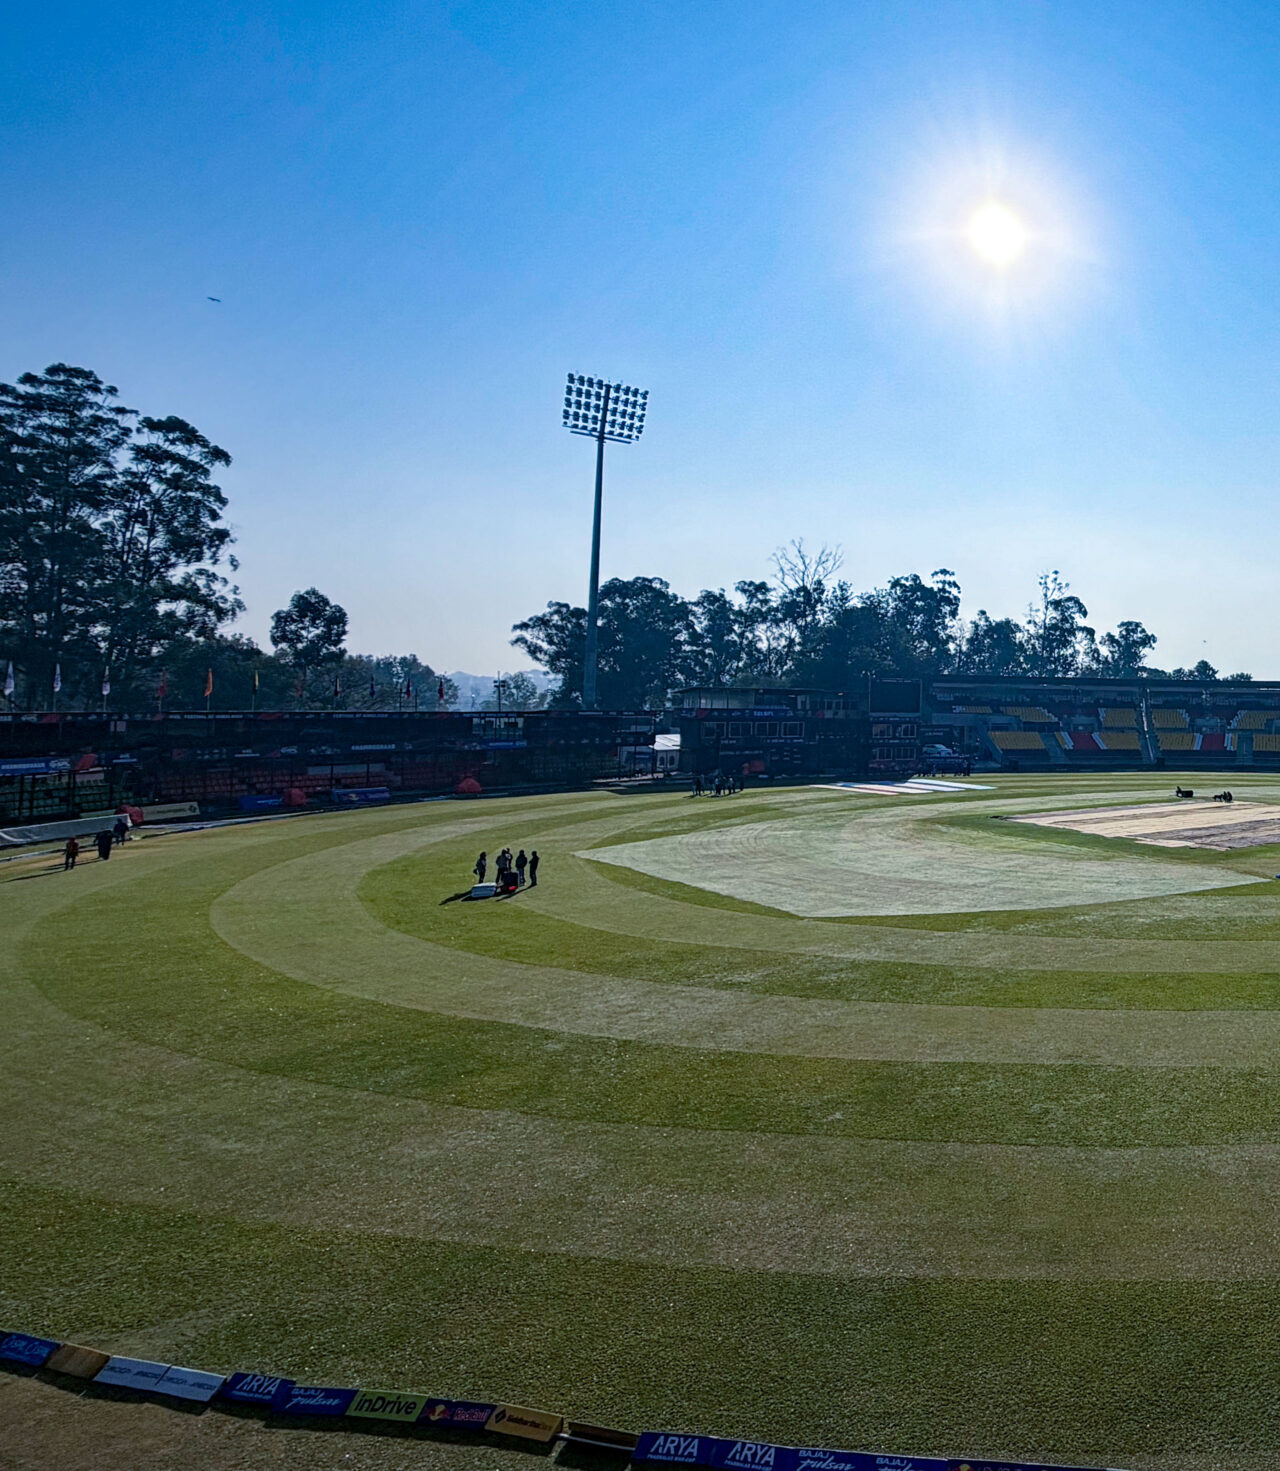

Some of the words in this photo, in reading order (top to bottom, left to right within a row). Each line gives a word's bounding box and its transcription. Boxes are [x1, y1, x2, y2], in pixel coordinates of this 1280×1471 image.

[236, 1374, 281, 1395] ARYA
[354, 1394, 417, 1415] inDrive
[649, 1435, 700, 1458] ARYA
[727, 1442, 776, 1466] ARYA
[798, 1450, 830, 1459] BAJAJ
[876, 1457, 907, 1467] BAJAJ
